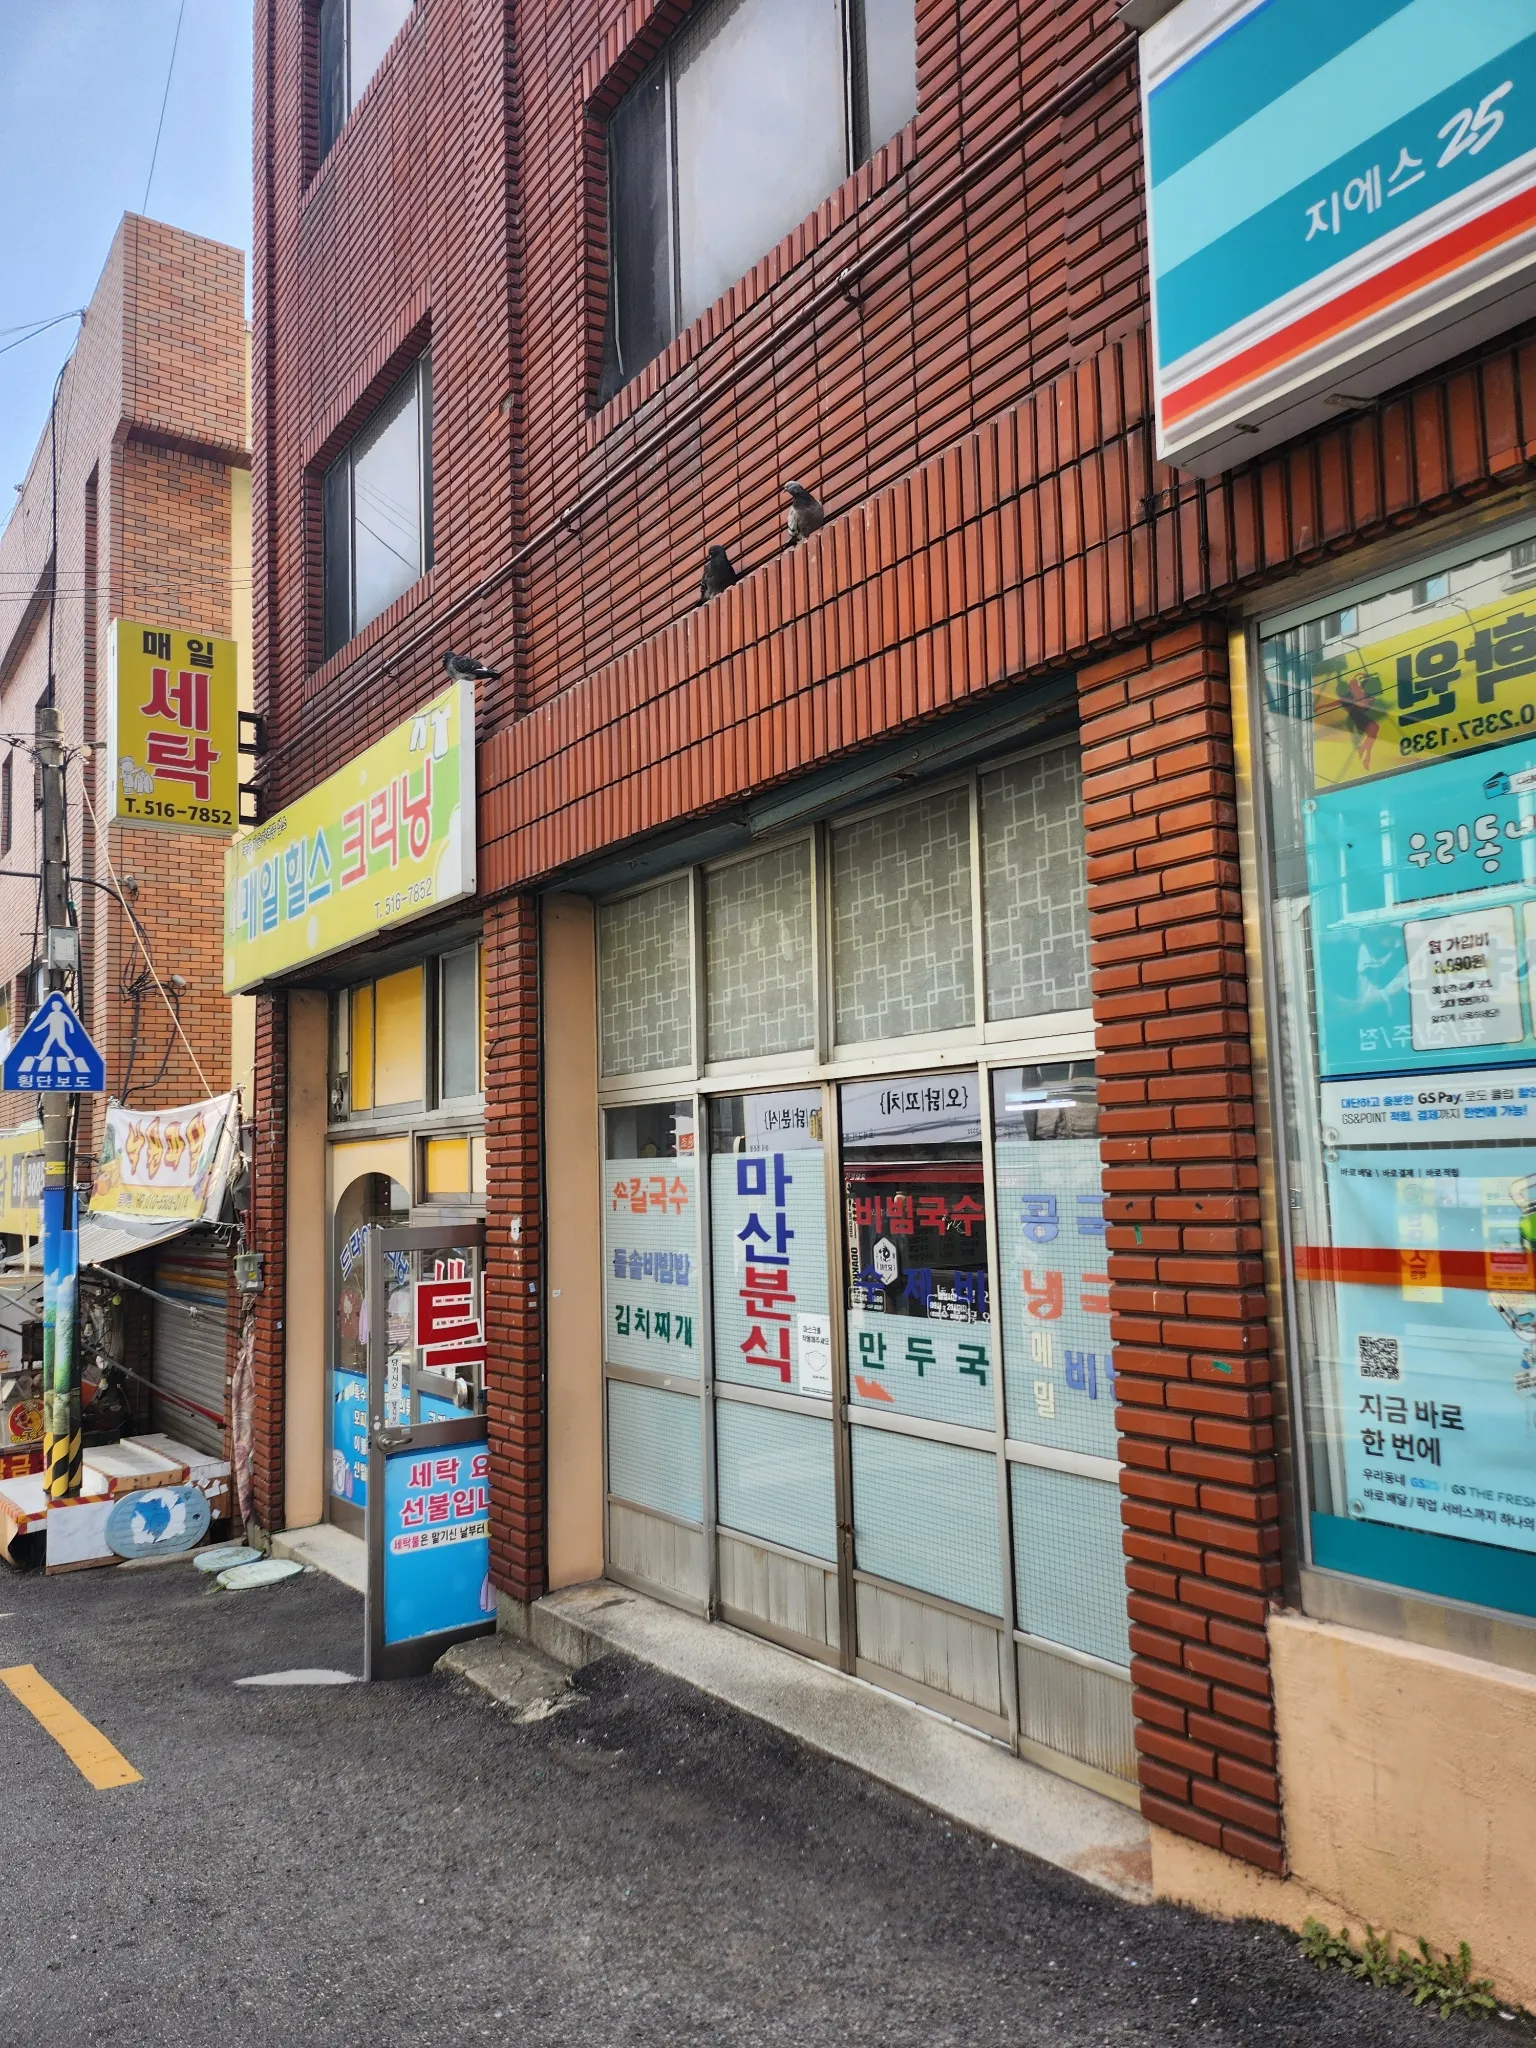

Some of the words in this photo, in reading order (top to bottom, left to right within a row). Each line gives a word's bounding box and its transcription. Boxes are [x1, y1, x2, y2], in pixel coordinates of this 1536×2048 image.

[1305, 146, 1426, 242] 지에스
[1436, 80, 1513, 169] 25
[142, 630, 214, 669] 매일
[139, 667, 221, 801] 세탁
[144, 800, 232, 825] 516-7852
[340, 757, 433, 890] 크리닝
[385, 877, 432, 915] 516-7852
[17, 1075, 91, 1088] 횡단보도
[1418, 1092, 1436, 1105] GS
[1342, 1111, 1387, 1124] GS&POINT
[855, 1195, 985, 1237] 비빔국수
[737, 1153, 796, 1383] 마산분식
[615, 1304, 692, 1348] 김치찌개
[859, 1332, 990, 1387] 만두국
[1359, 1394, 1408, 1425] 지금
[1414, 1400, 1464, 1431] 바로
[1360, 1428, 1385, 1457] 한
[1391, 1433, 1442, 1467] 번에
[408, 1456, 460, 1489] 세탁
[1362, 1467, 1406, 1486] 우리동네
[1469, 1486, 1494, 1501] THE
[1363, 1487, 1384, 1502] 바로
[1441, 1501, 1497, 1525] 서비스까지
[393, 1533, 428, 1551] 세탁물은
[459, 1523, 485, 1540] 날부터
